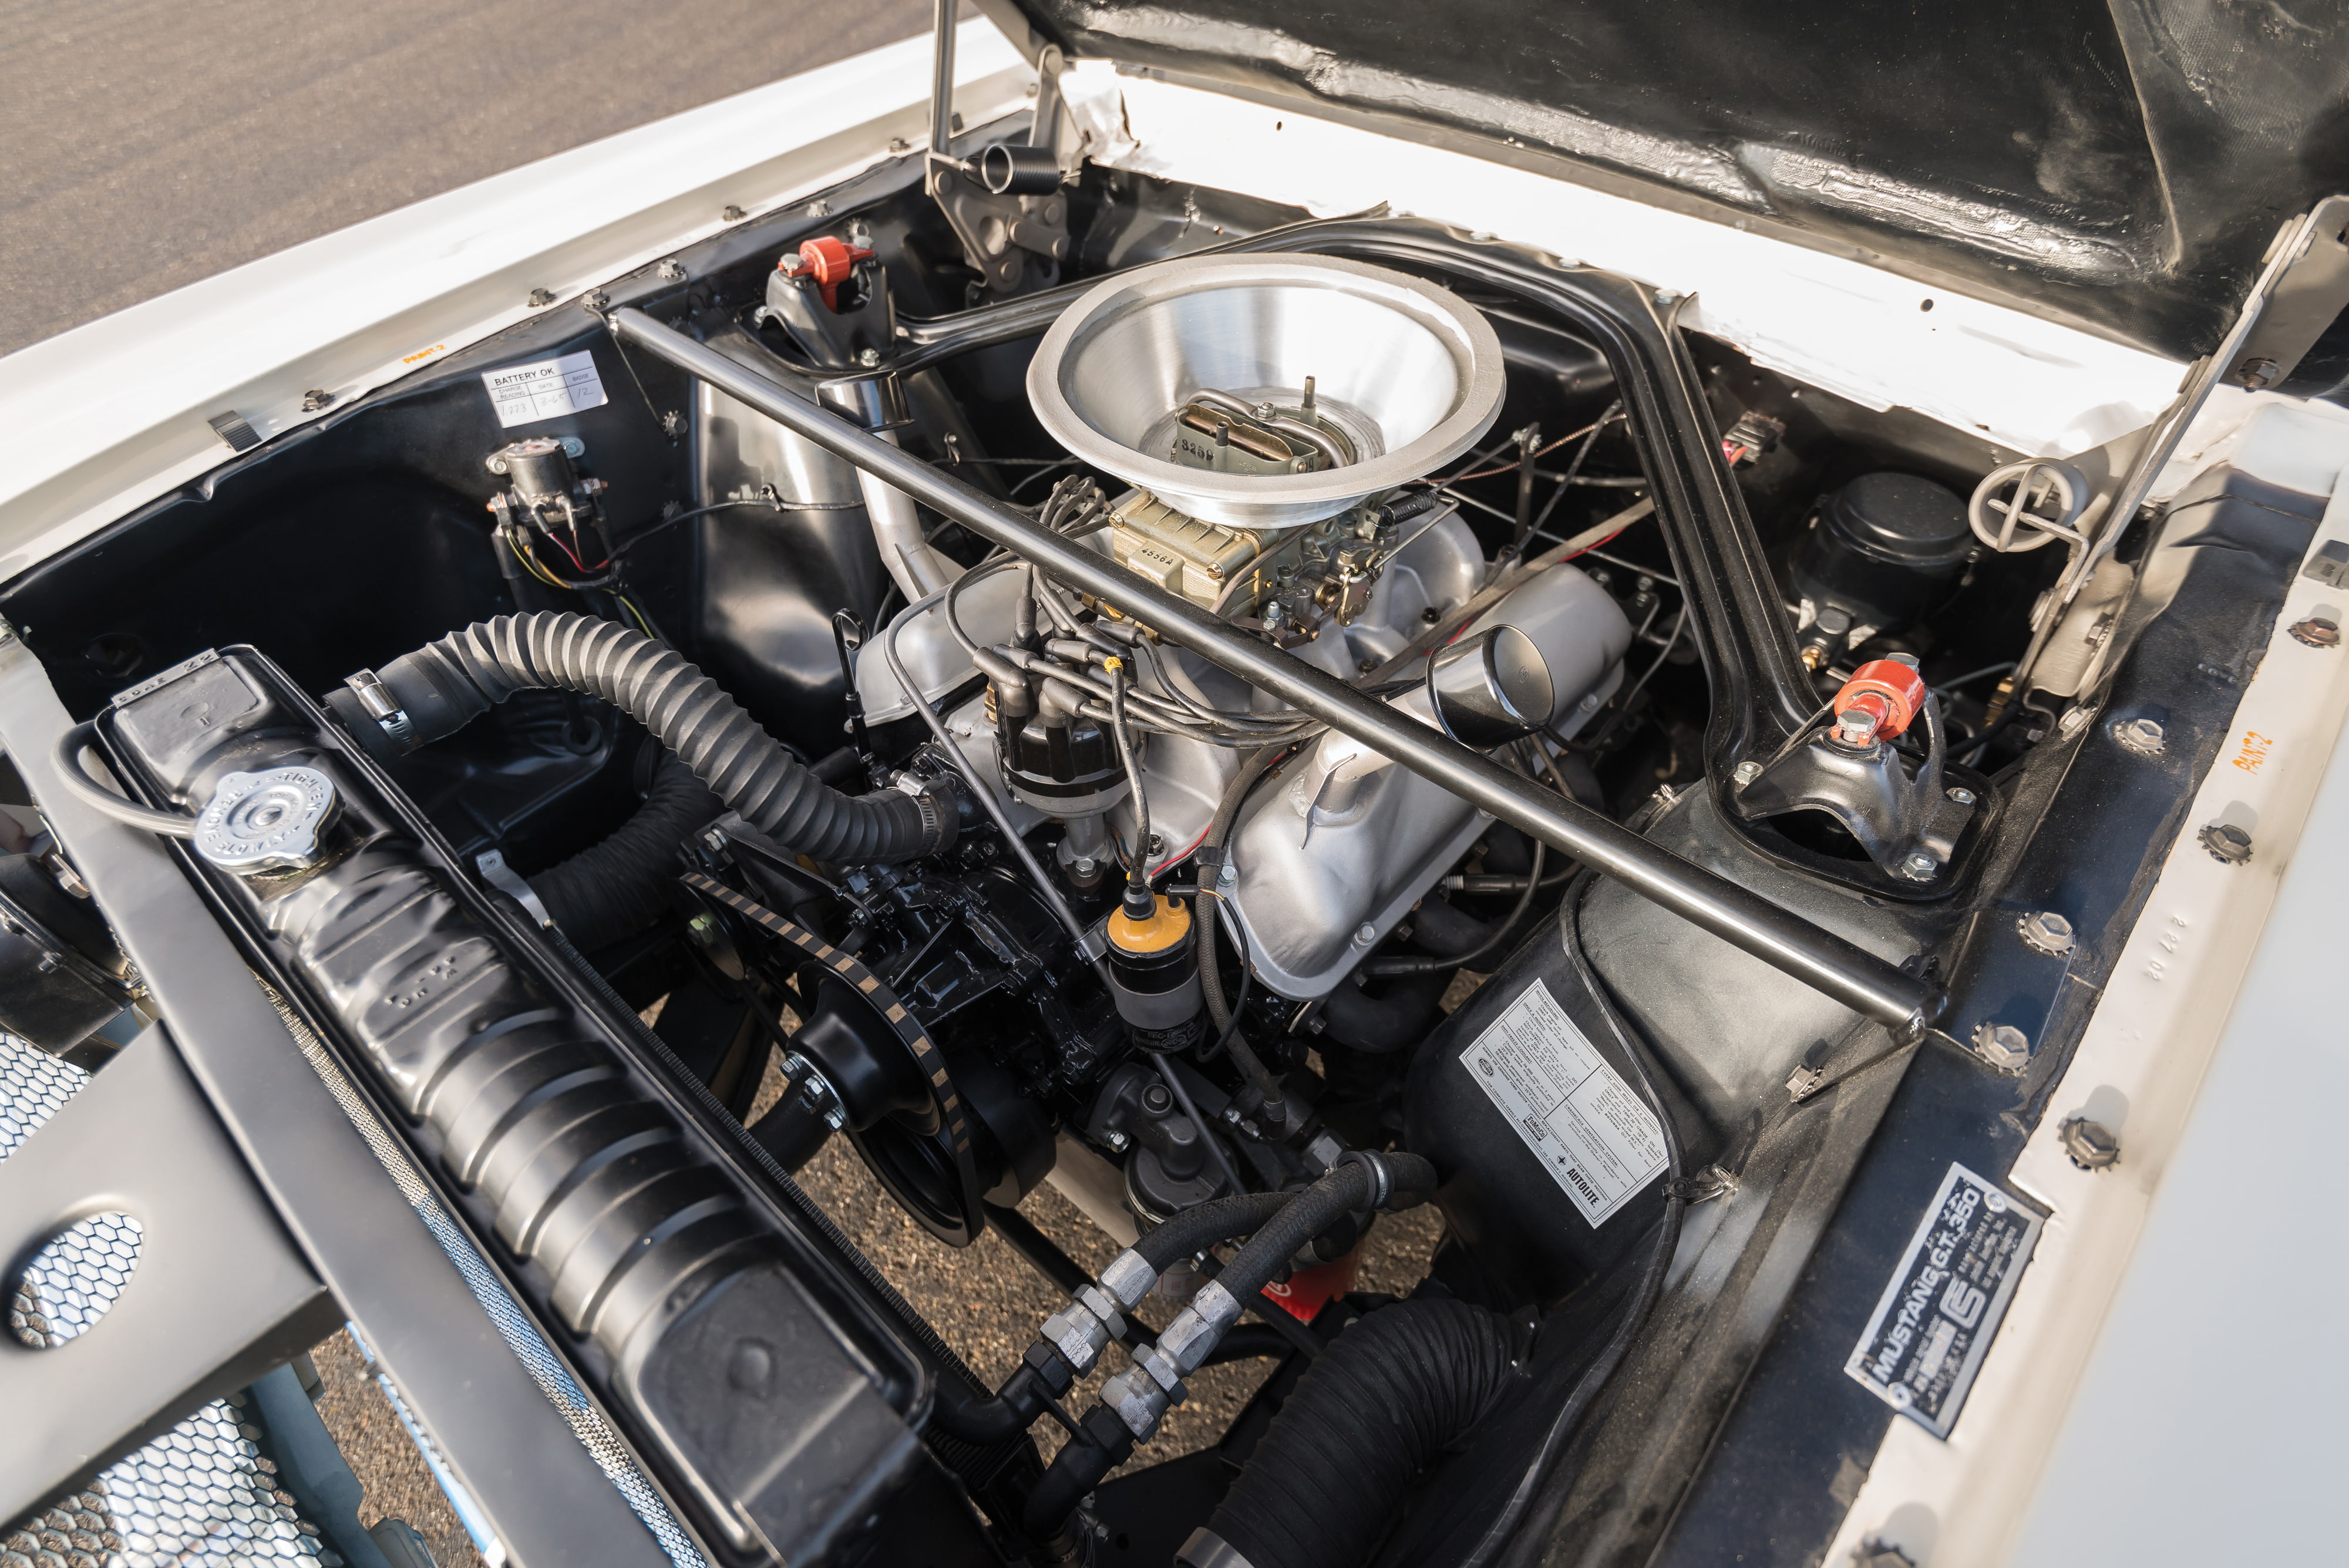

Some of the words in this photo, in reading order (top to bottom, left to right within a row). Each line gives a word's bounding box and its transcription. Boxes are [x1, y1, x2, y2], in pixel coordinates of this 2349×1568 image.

[494, 371, 536, 386] BATTERY
[540, 368, 555, 376] OK
[573, 373, 590, 382] BADGE
[499, 385, 522, 393] CHARGE
[500, 391, 525, 400] READING
[1141, 548, 1173, 566] 4556A
[282, 772, 324, 811] TIGHTEN
[1527, 1115, 1544, 1137] FoMoCo
[1566, 1168, 1599, 1207] AUTOLITE.
[1872, 1264, 1950, 1383] MUSTANG
[1948, 1187, 1981, 1234] 350
